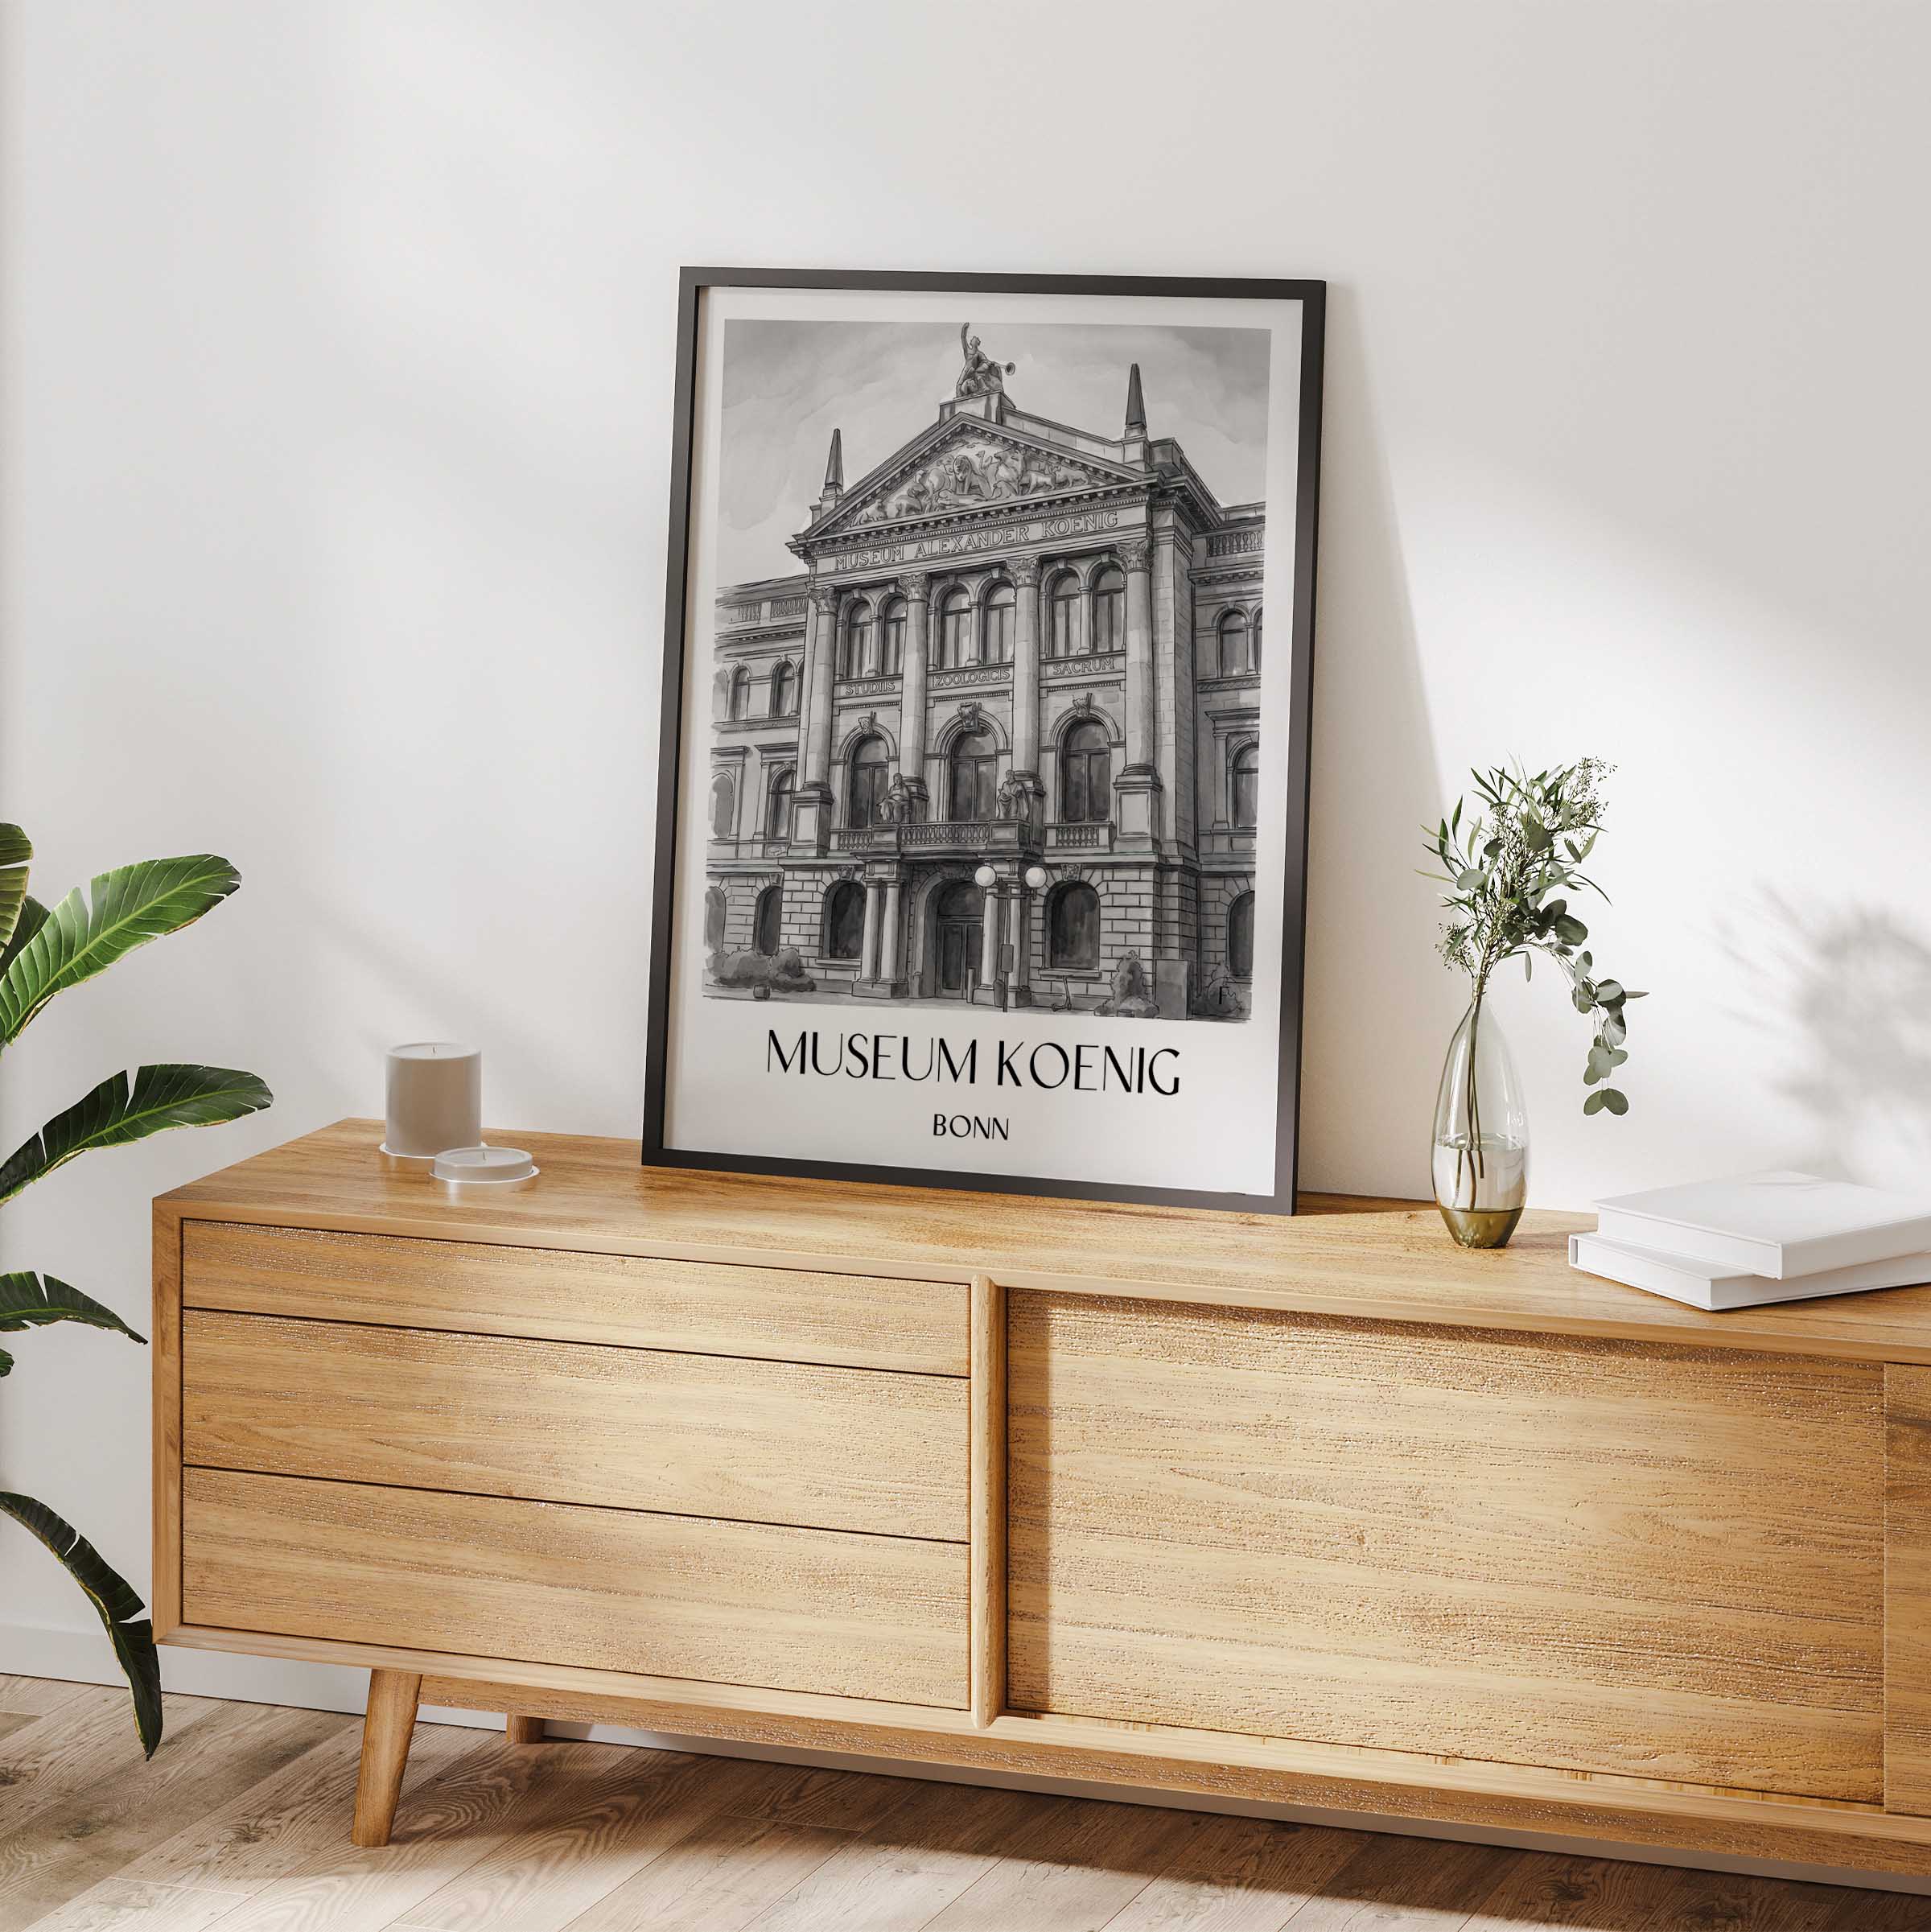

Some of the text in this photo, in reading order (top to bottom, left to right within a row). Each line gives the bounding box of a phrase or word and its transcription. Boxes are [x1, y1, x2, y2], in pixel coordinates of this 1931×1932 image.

[834, 511, 1118, 570] MUSEUM ALEXANDER KOENIG
[934, 668, 1011, 687] ZOOLOGICIS
[1052, 657, 1115, 675] SACRUM
[768, 1029, 1180, 1096] MUSEUM KOENIG
[933, 1113, 1009, 1141] BONN
